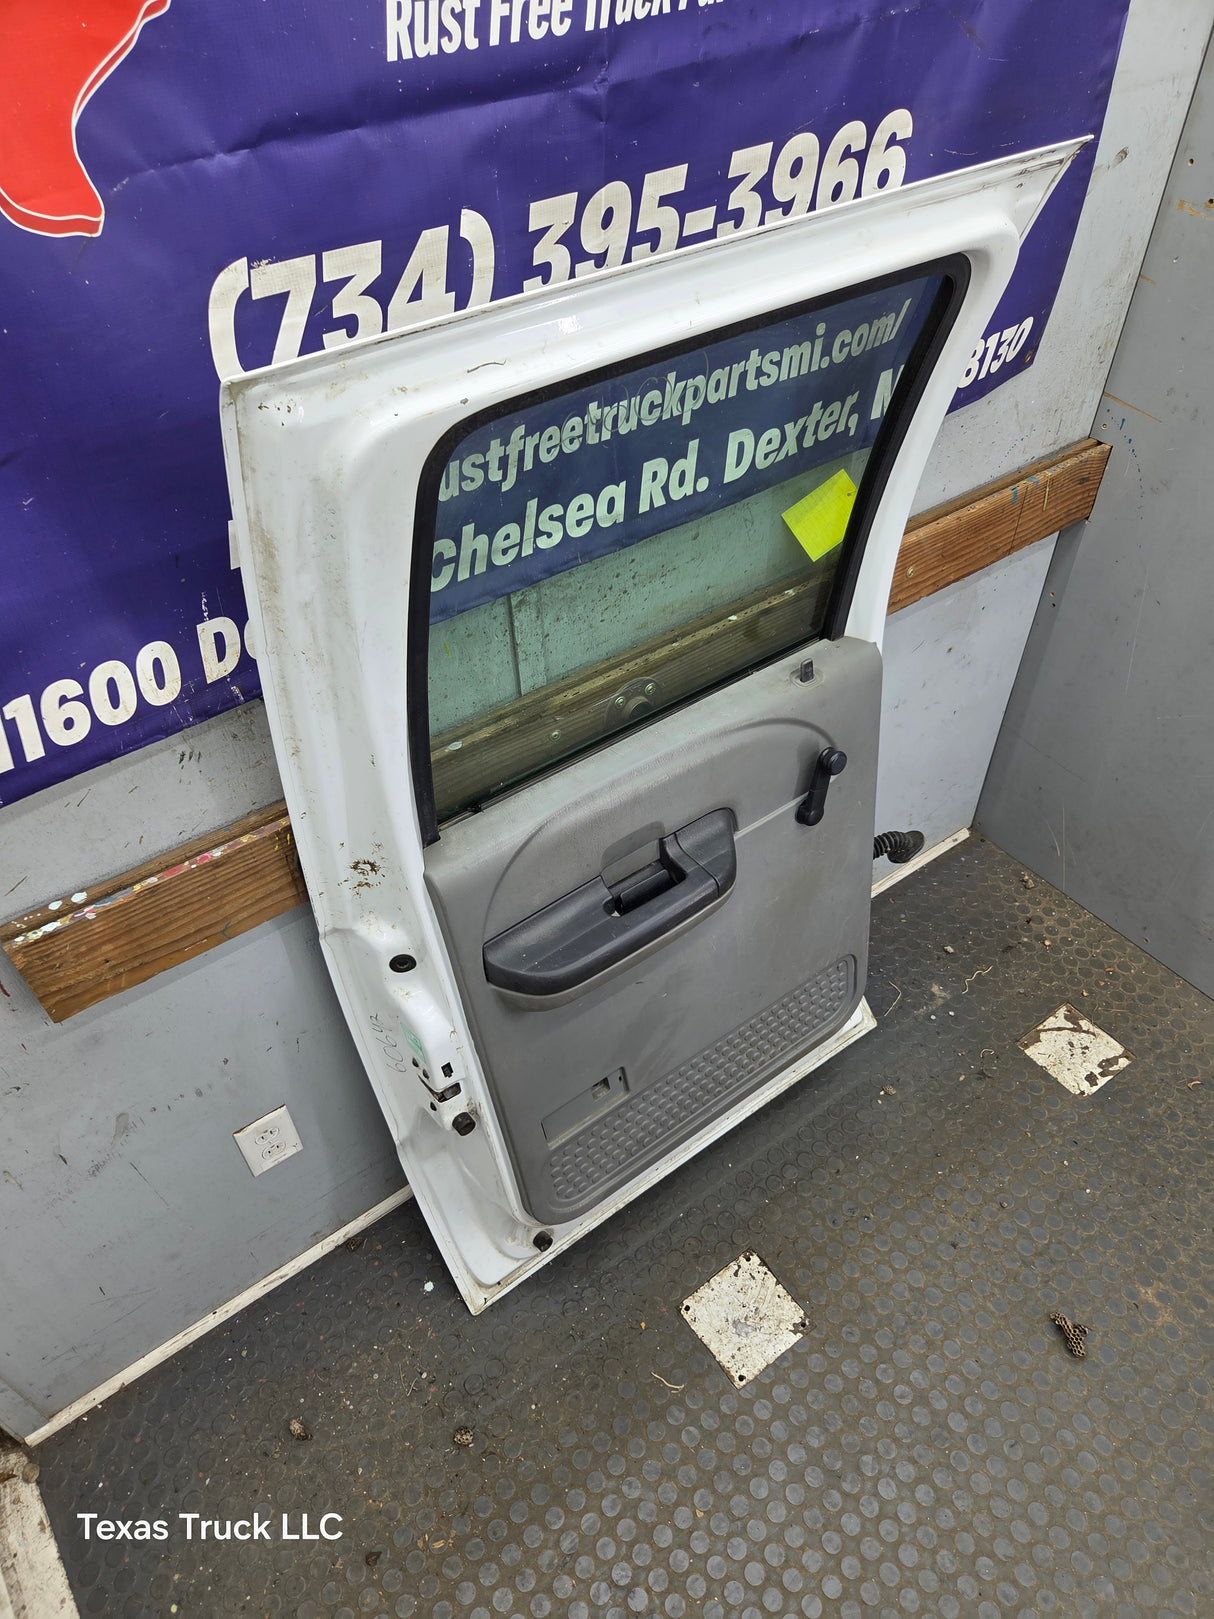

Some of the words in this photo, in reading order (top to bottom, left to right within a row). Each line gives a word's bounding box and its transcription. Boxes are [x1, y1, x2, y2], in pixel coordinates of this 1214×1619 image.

[386, 0, 480, 62] Rust
[208, 208, 494, 382] (734)
[523, 108, 914, 292] 395-3966
[638, 438, 710, 514] Rd.
[723, 390, 860, 484] Dexter,
